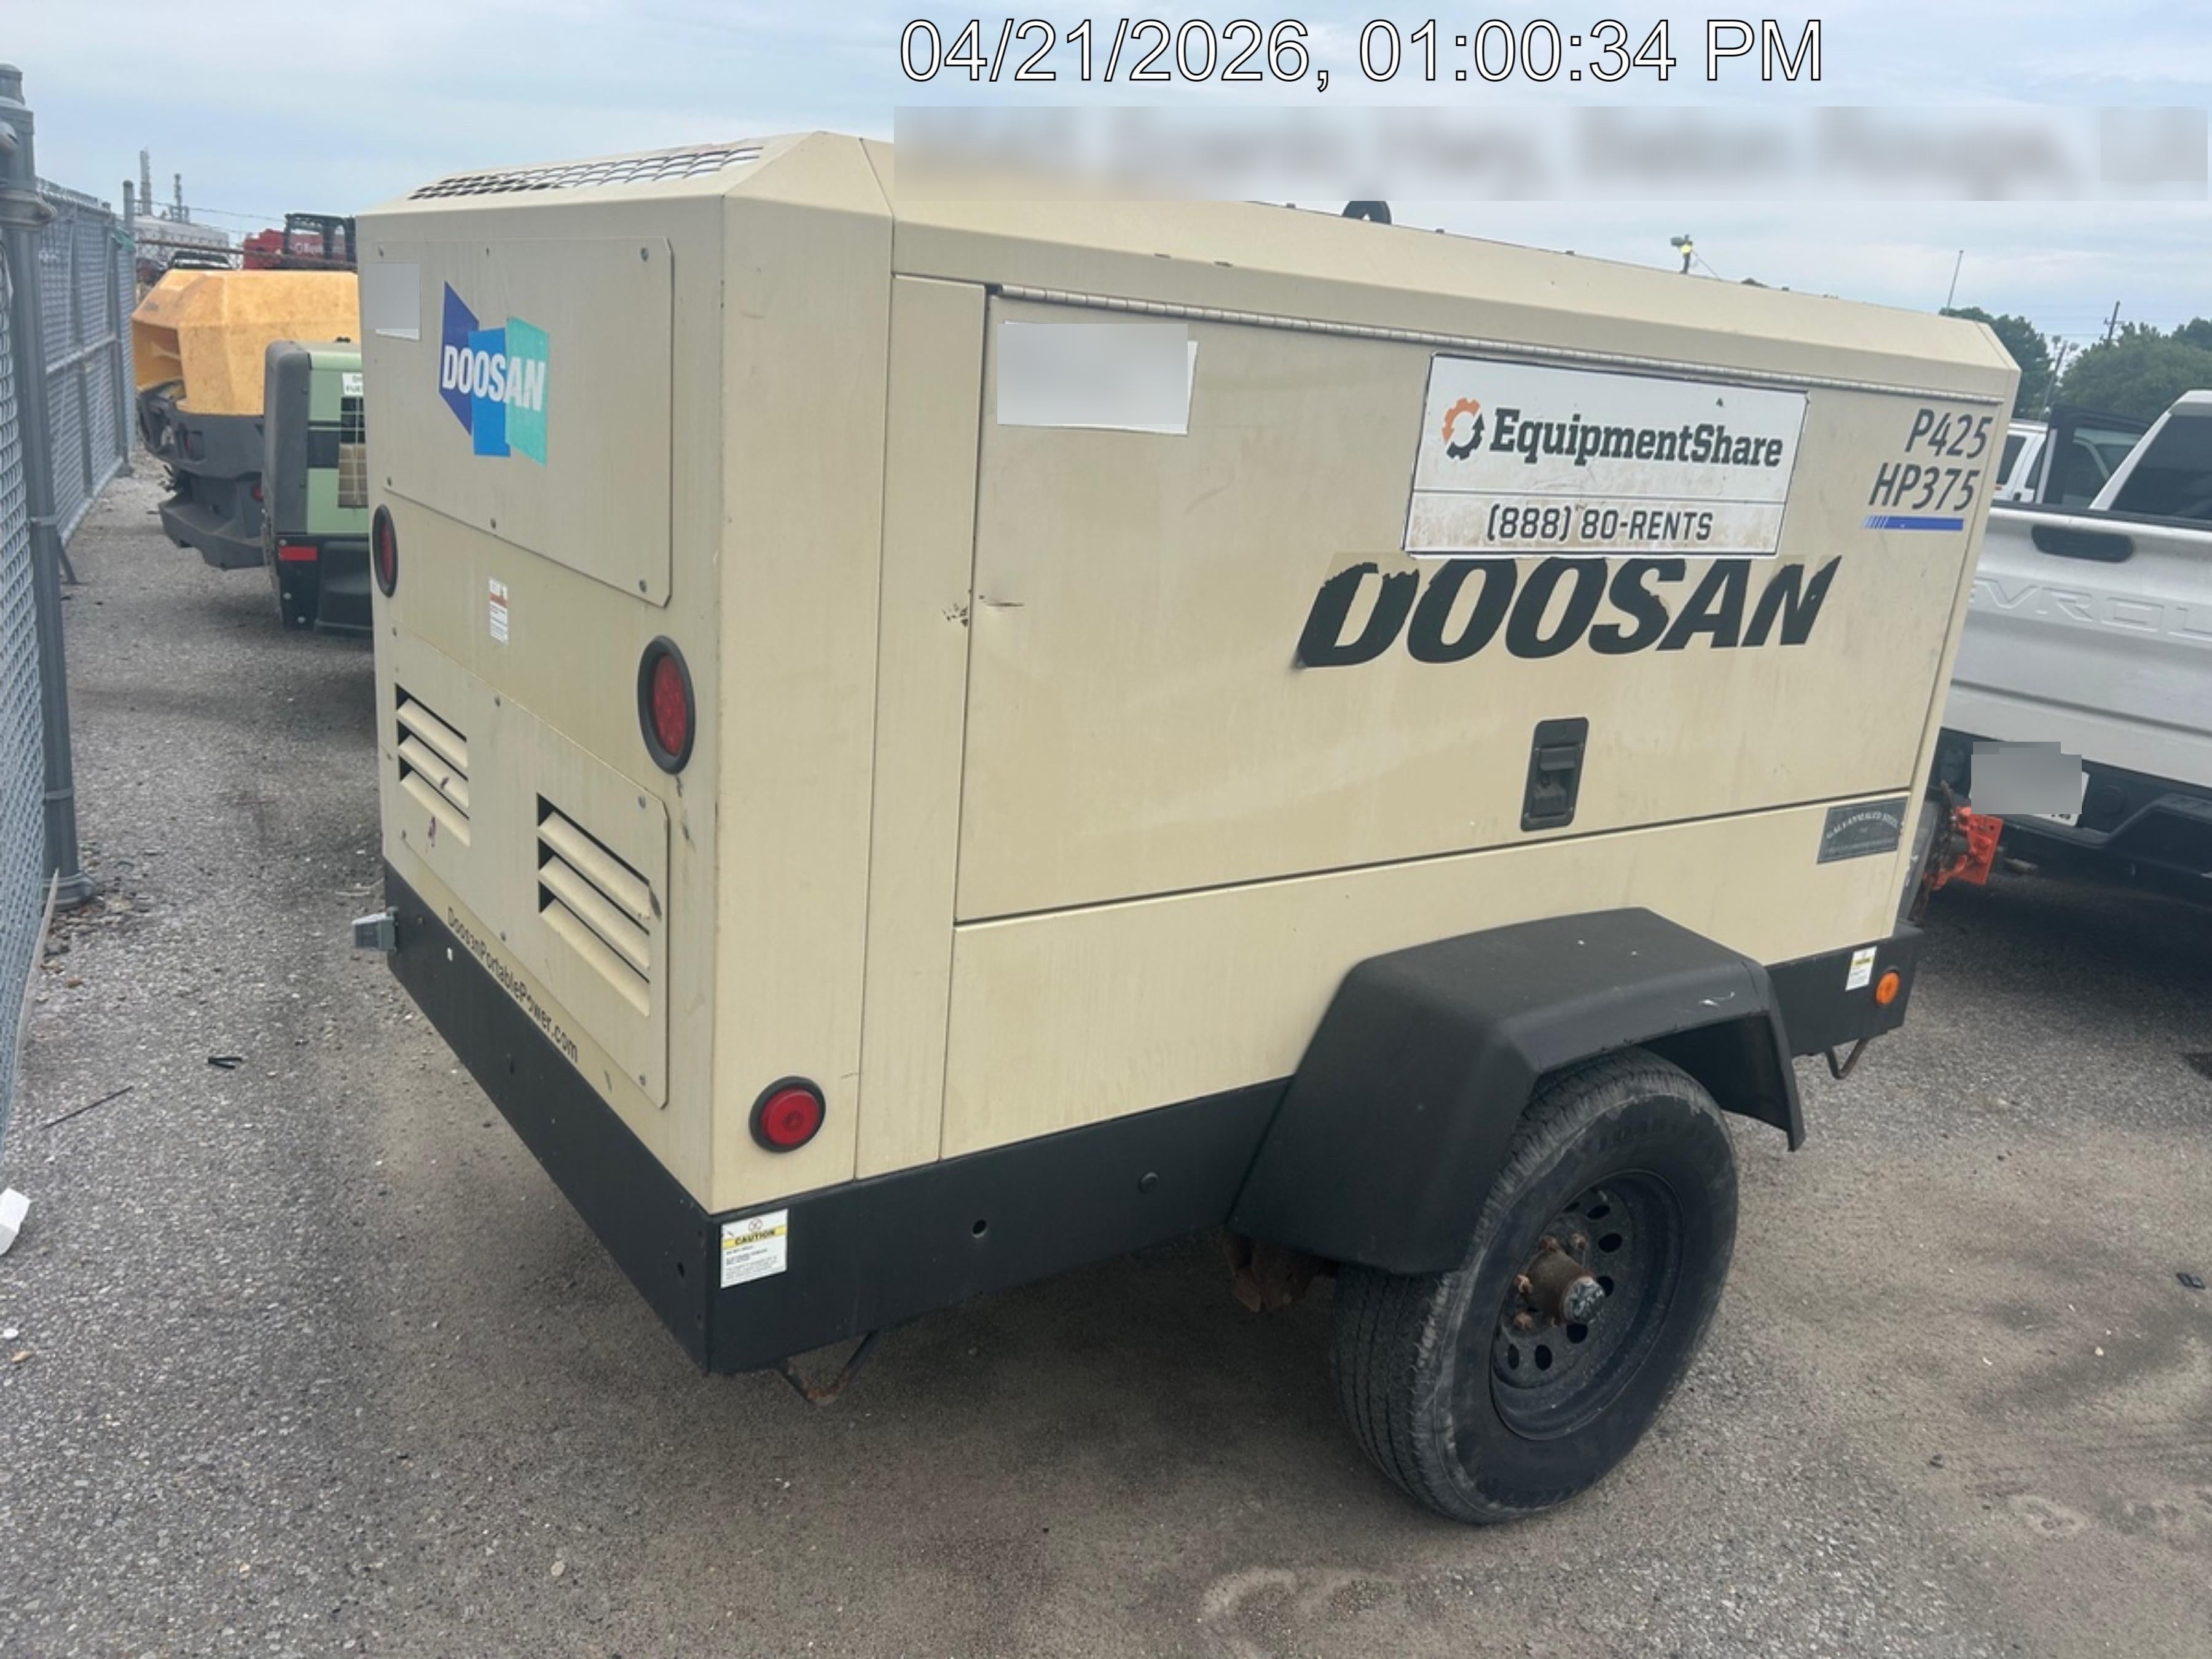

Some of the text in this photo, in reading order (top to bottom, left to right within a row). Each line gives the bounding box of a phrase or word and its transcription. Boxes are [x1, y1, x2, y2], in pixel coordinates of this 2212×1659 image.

[442, 344, 546, 412] DOOSAN
[1489, 409, 1783, 467] EquipmentShare
[1904, 408, 1993, 460] P425
[1868, 462, 1980, 511] HP375
[1487, 504, 1714, 541] (888) 80-RENTS
[1296, 555, 1842, 668] DOOSAN
[447, 906, 578, 1063] DoosanPortablePower.com
[734, 1229, 775, 1247] CAUTION
